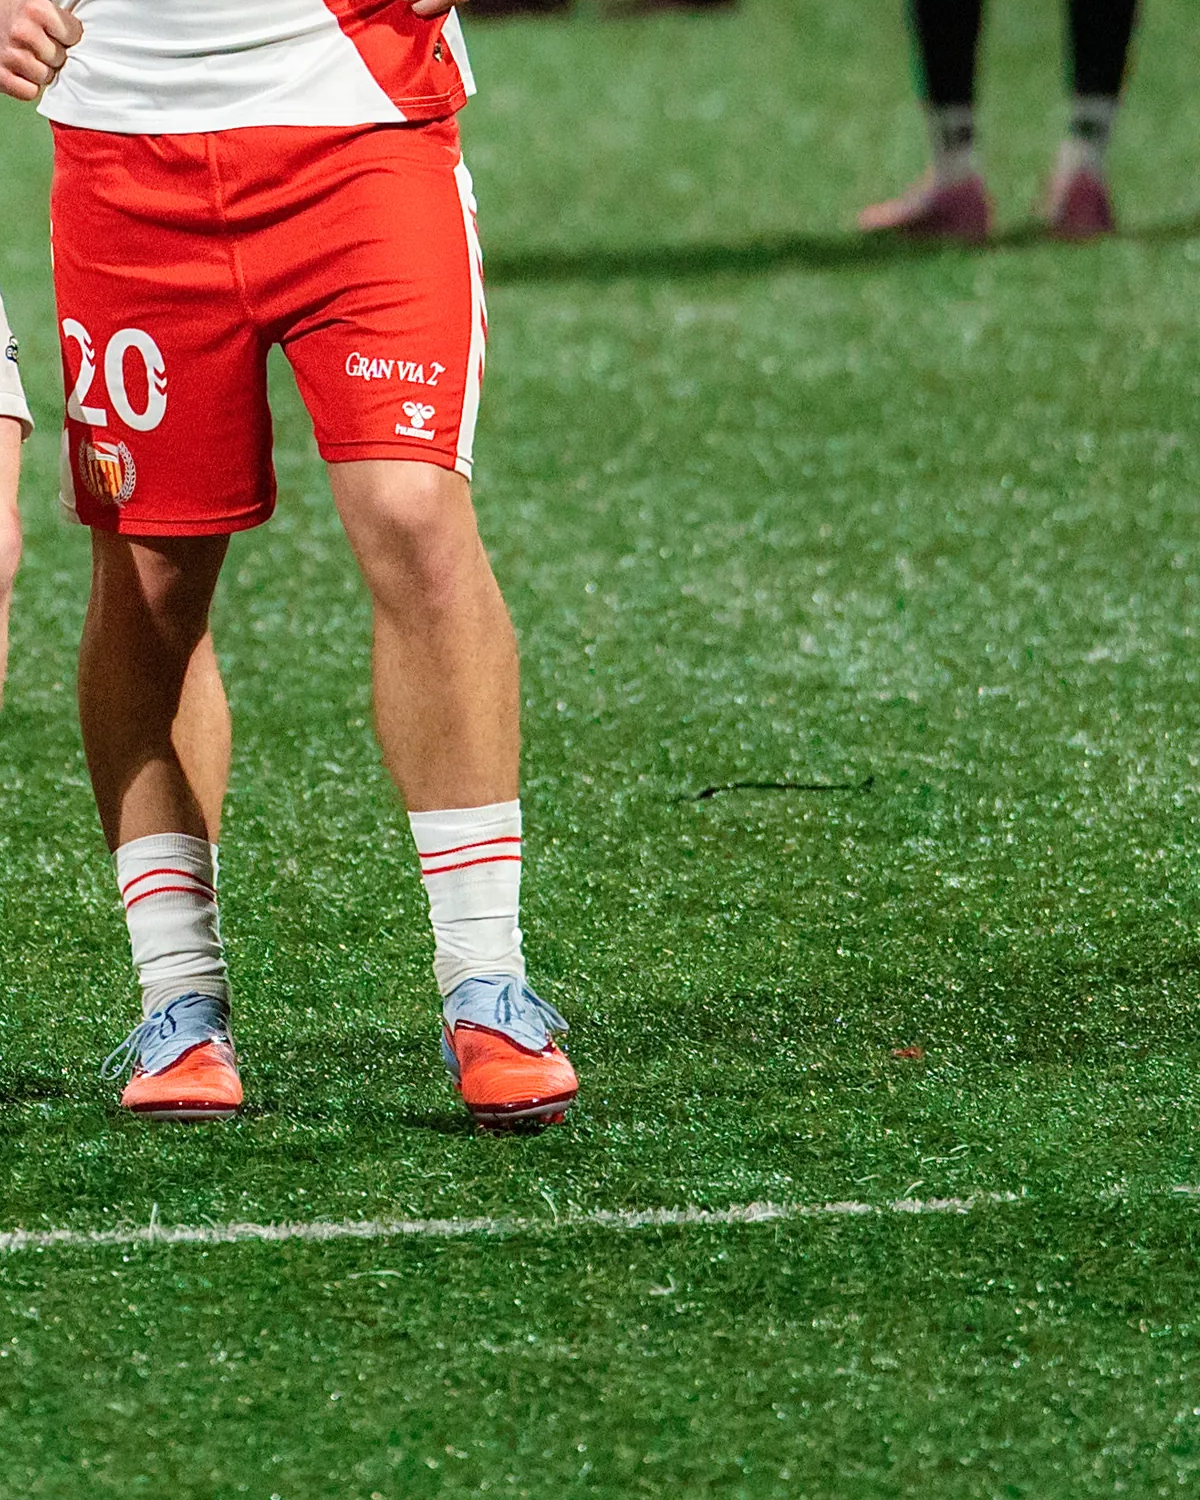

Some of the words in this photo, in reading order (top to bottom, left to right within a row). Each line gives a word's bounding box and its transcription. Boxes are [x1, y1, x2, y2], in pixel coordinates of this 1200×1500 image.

[62, 318, 167, 432] 20
[345, 352, 395, 381] GRAN
[397, 360, 425, 384] VIA
